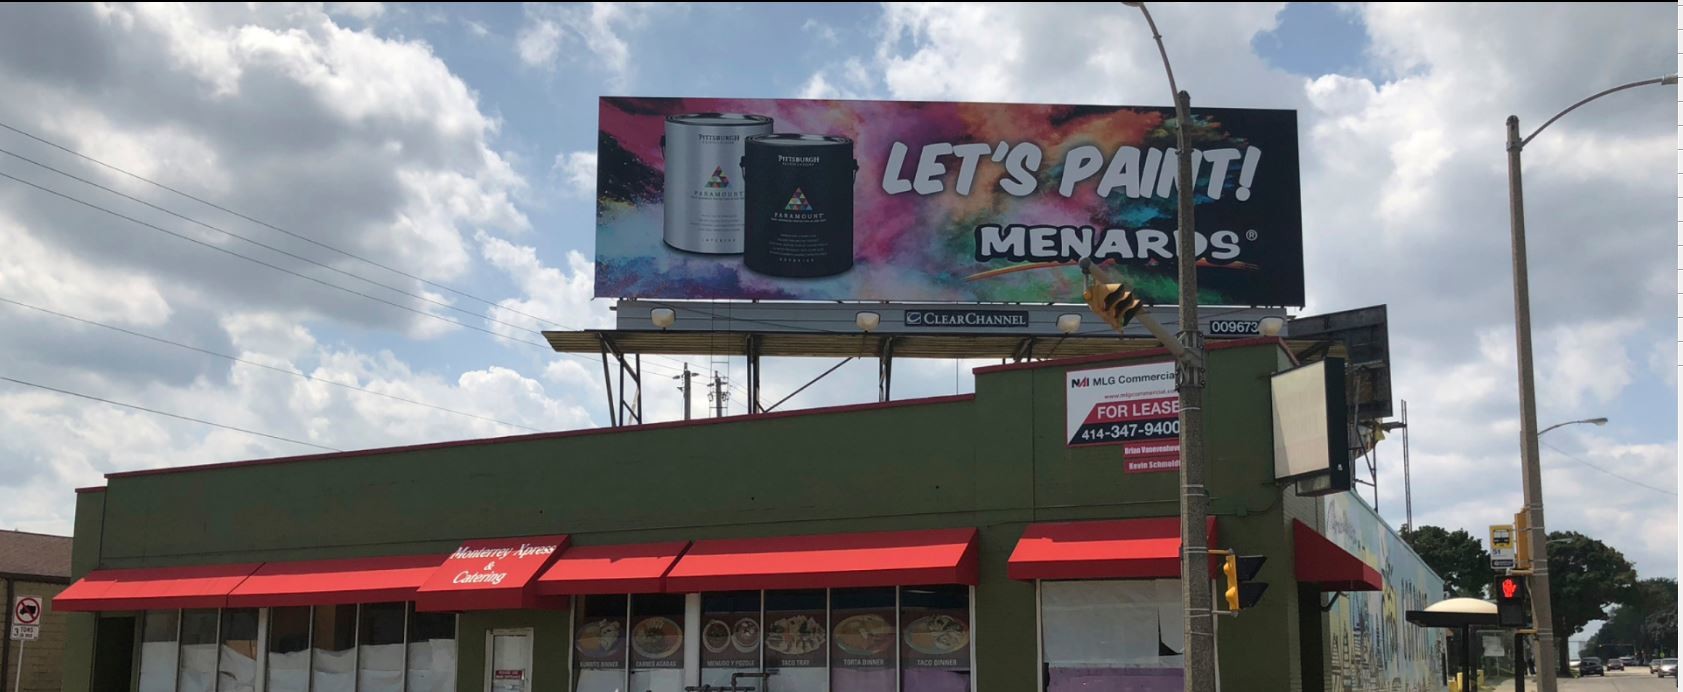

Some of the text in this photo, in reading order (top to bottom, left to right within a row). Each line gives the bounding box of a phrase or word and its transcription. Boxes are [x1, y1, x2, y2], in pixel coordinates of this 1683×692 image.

[882, 141, 1262, 201] LET'S PAINT!
[1211, 320, 1258, 333] 009673
[1092, 376, 1116, 387] MLG
[1118, 371, 1175, 385] Commercia
[1097, 401, 1180, 419] FOR LEASE
[1081, 421, 1180, 440] 414-347-9400
[1128, 462, 1148, 470] Kevin
[449, 543, 557, 560] Monterrey Xpress
[483, 560, 495, 571] &
[452, 570, 508, 585] Catering
